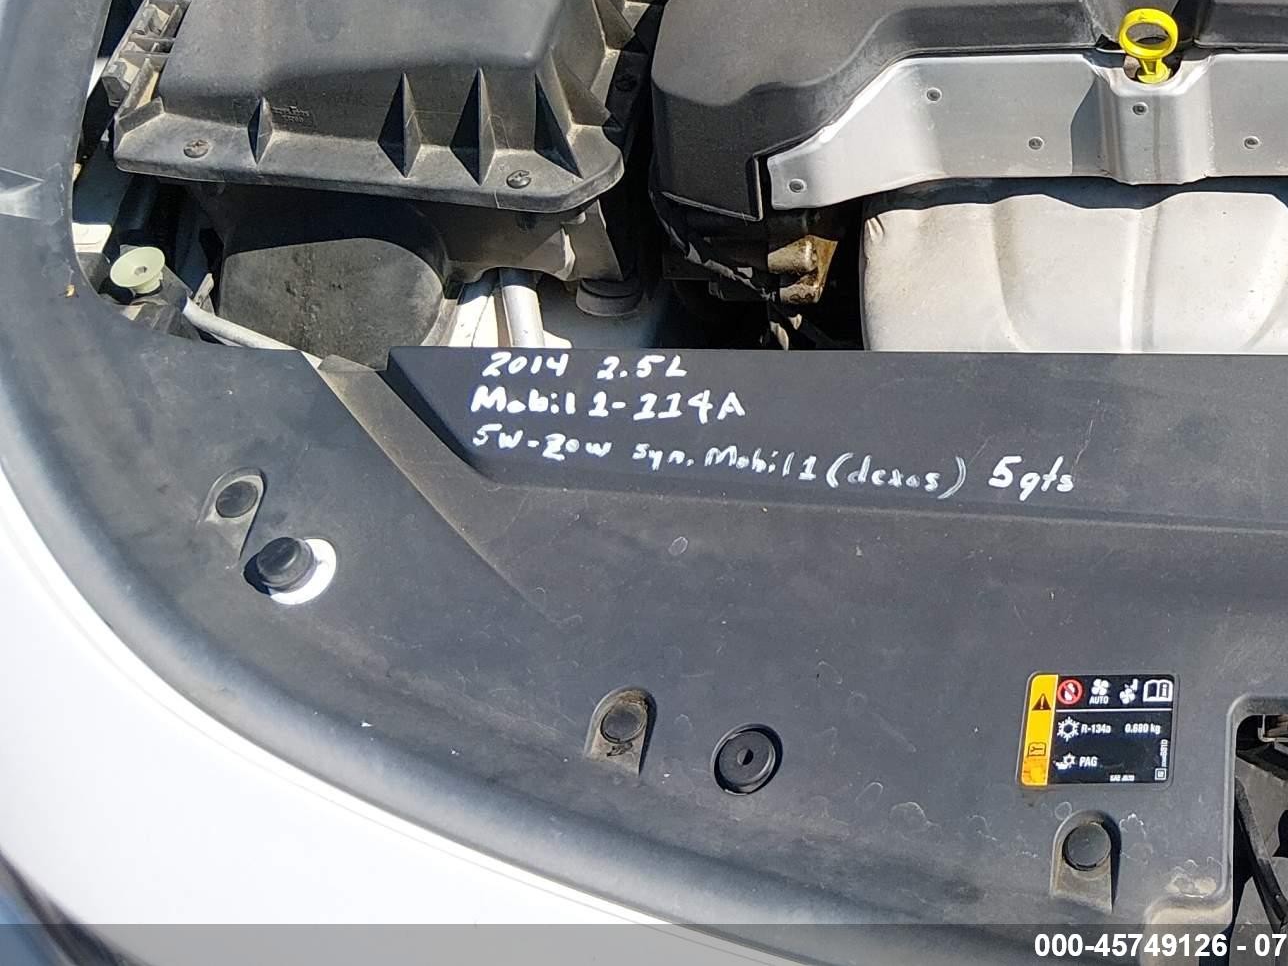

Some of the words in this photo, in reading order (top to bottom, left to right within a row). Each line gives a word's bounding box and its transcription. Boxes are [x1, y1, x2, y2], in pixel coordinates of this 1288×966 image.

[482, 352, 569, 377] 2014
[596, 354, 688, 380] 2.5L
[470, 385, 576, 413] Mobil
[1089, 695, 1109, 705] AUTO
[1080, 723, 1112, 734] R-134a
[1150, 723, 1161, 735] kg
[1079, 756, 1098, 767] PAG
